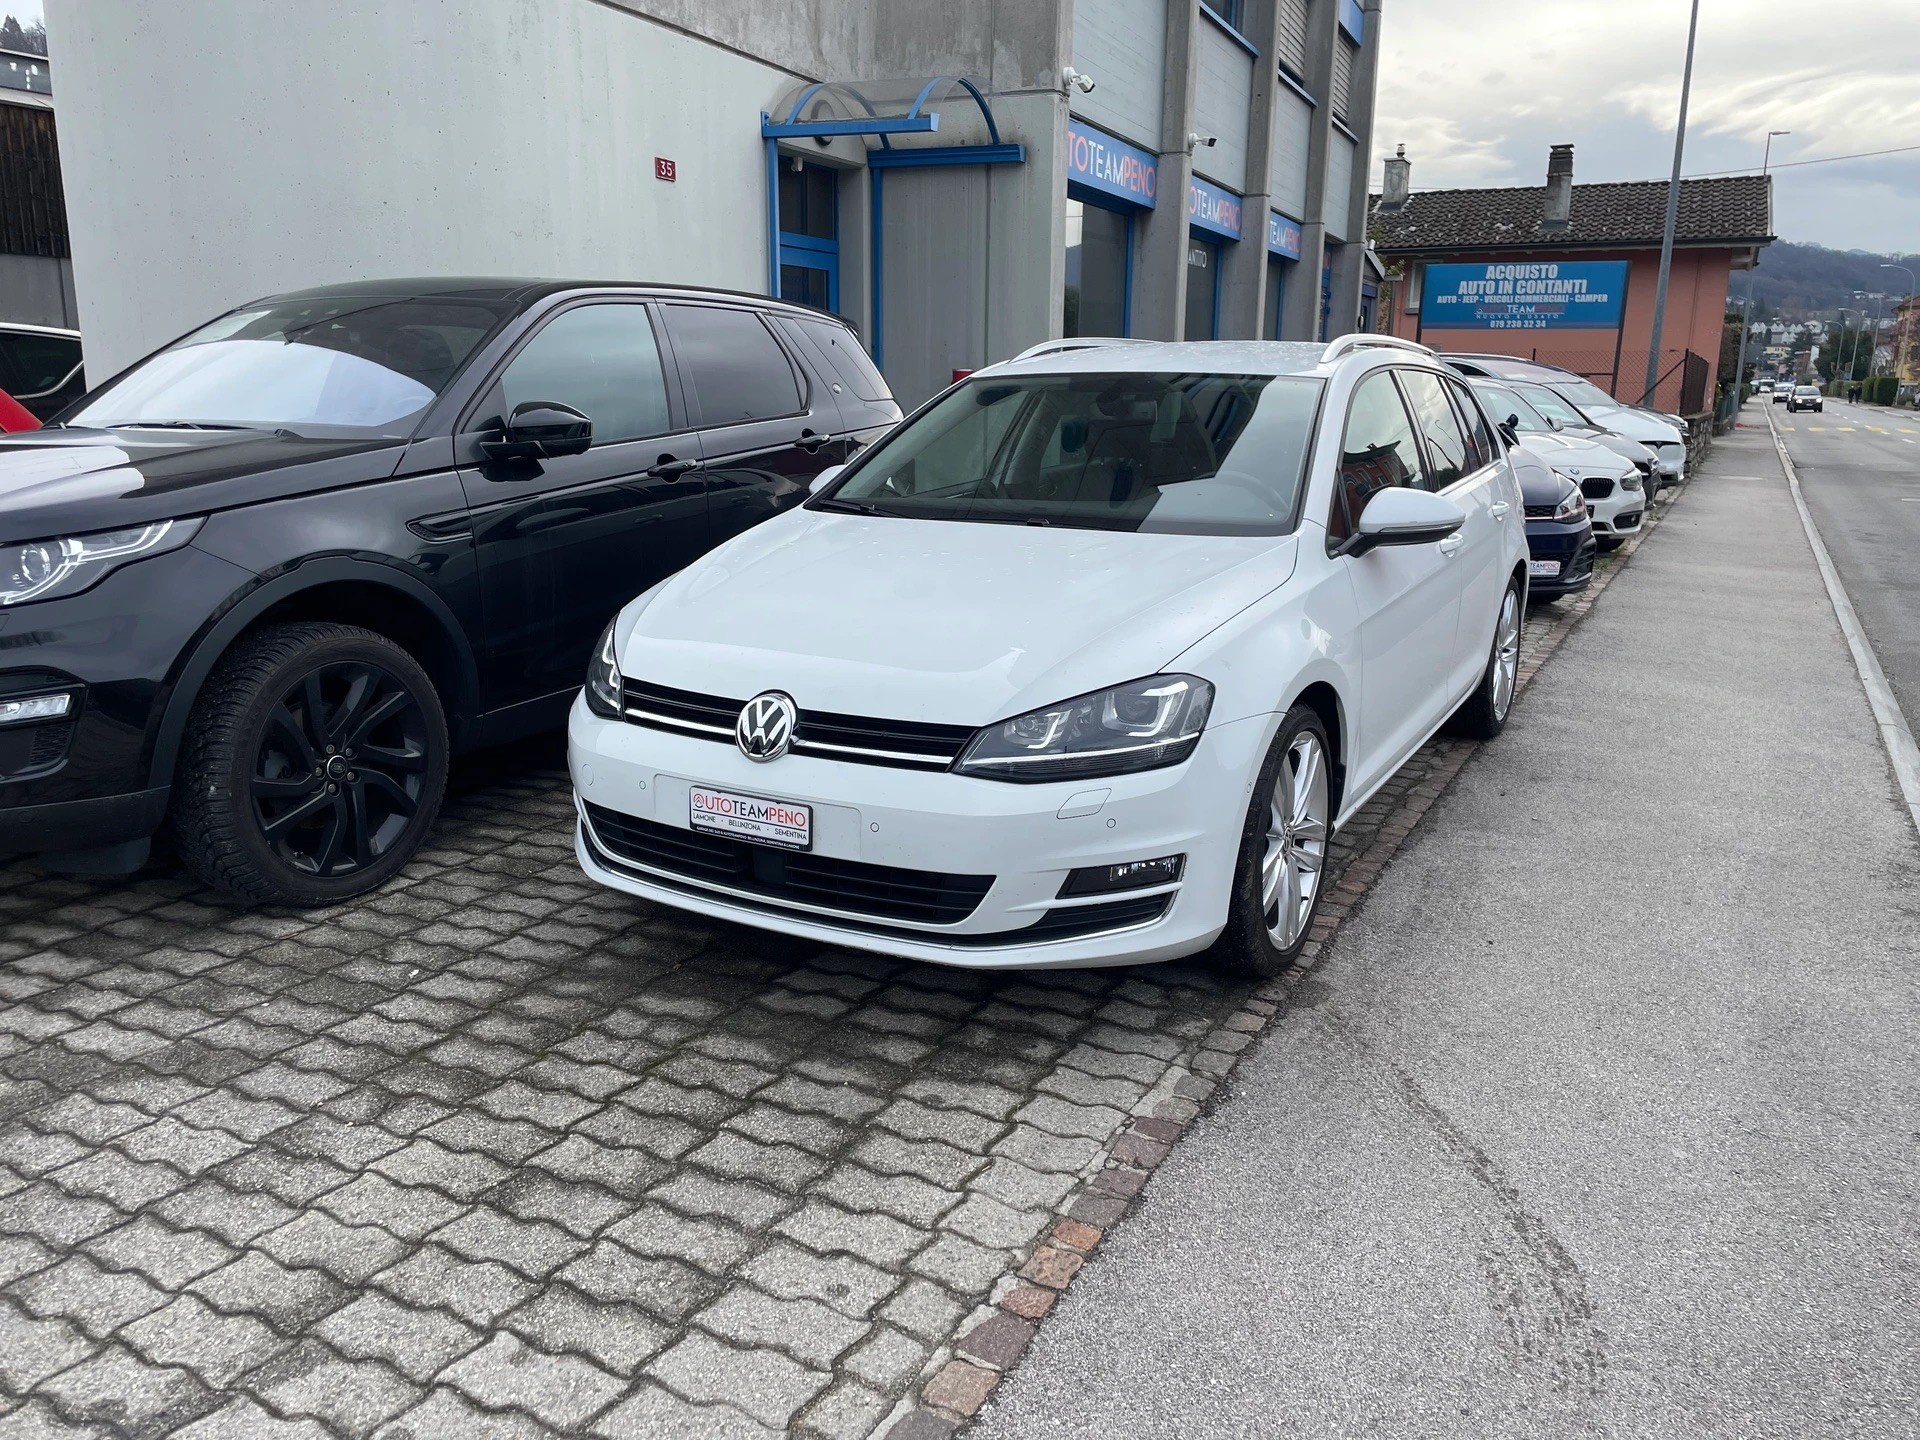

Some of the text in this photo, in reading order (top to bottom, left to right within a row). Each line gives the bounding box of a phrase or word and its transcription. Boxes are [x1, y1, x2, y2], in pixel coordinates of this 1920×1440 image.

[660, 161, 673, 177] 35
[1486, 264, 1559, 281] ACQUISTO
[1458, 279, 1588, 295] AUTO IN CONTANTI
[1484, 295, 1514, 303] VEICOLI
[1515, 294, 1569, 303] COMMERCIALI
[1575, 294, 1608, 303] CAMPER
[1490, 320, 1505, 328] 079
[1523, 320, 1534, 328] 32
[1535, 320, 1546, 328] 34
[694, 812, 716, 823] LAMONE
[729, 819, 761, 831] BELLINZONA
[775, 828, 808, 840] SEMENTINA
